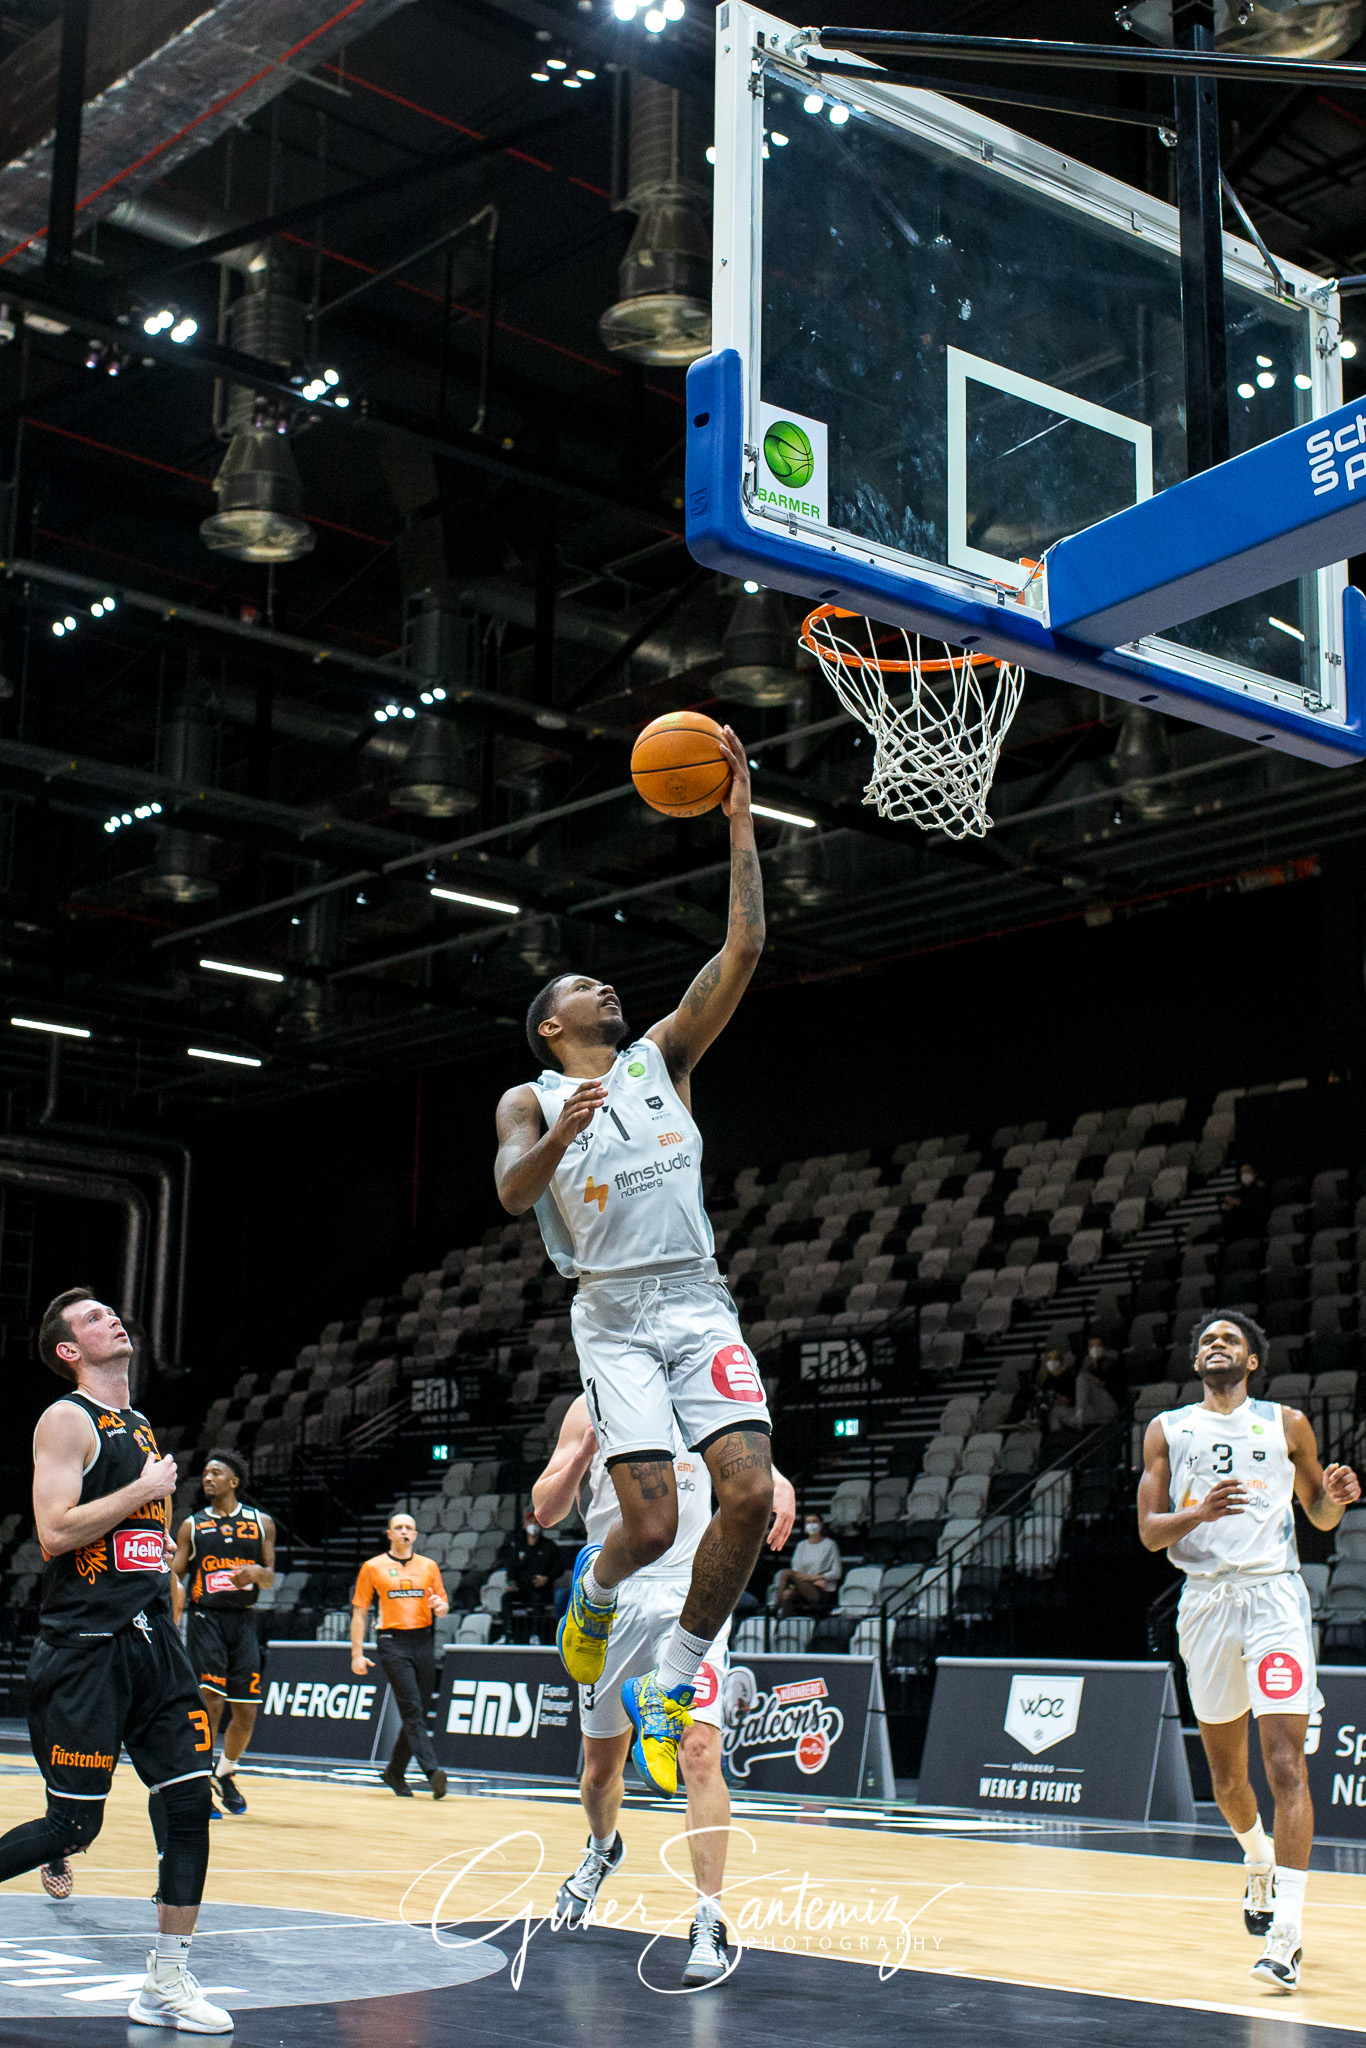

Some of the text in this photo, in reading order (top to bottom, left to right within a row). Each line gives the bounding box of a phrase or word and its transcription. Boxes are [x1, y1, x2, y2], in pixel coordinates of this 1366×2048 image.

[758, 488, 820, 519] BARMER
[657, 1131, 684, 1147] EMS
[614, 1152, 691, 1190] filmstudio
[620, 1178, 664, 1199] nürnberg
[1212, 1443, 1233, 1474] 3
[236, 1521, 259, 1540] 23
[446, 1679, 534, 1738] EMS
[722, 1694, 826, 1752] Falcons
[1030, 1780, 1083, 1804] EVENTS
